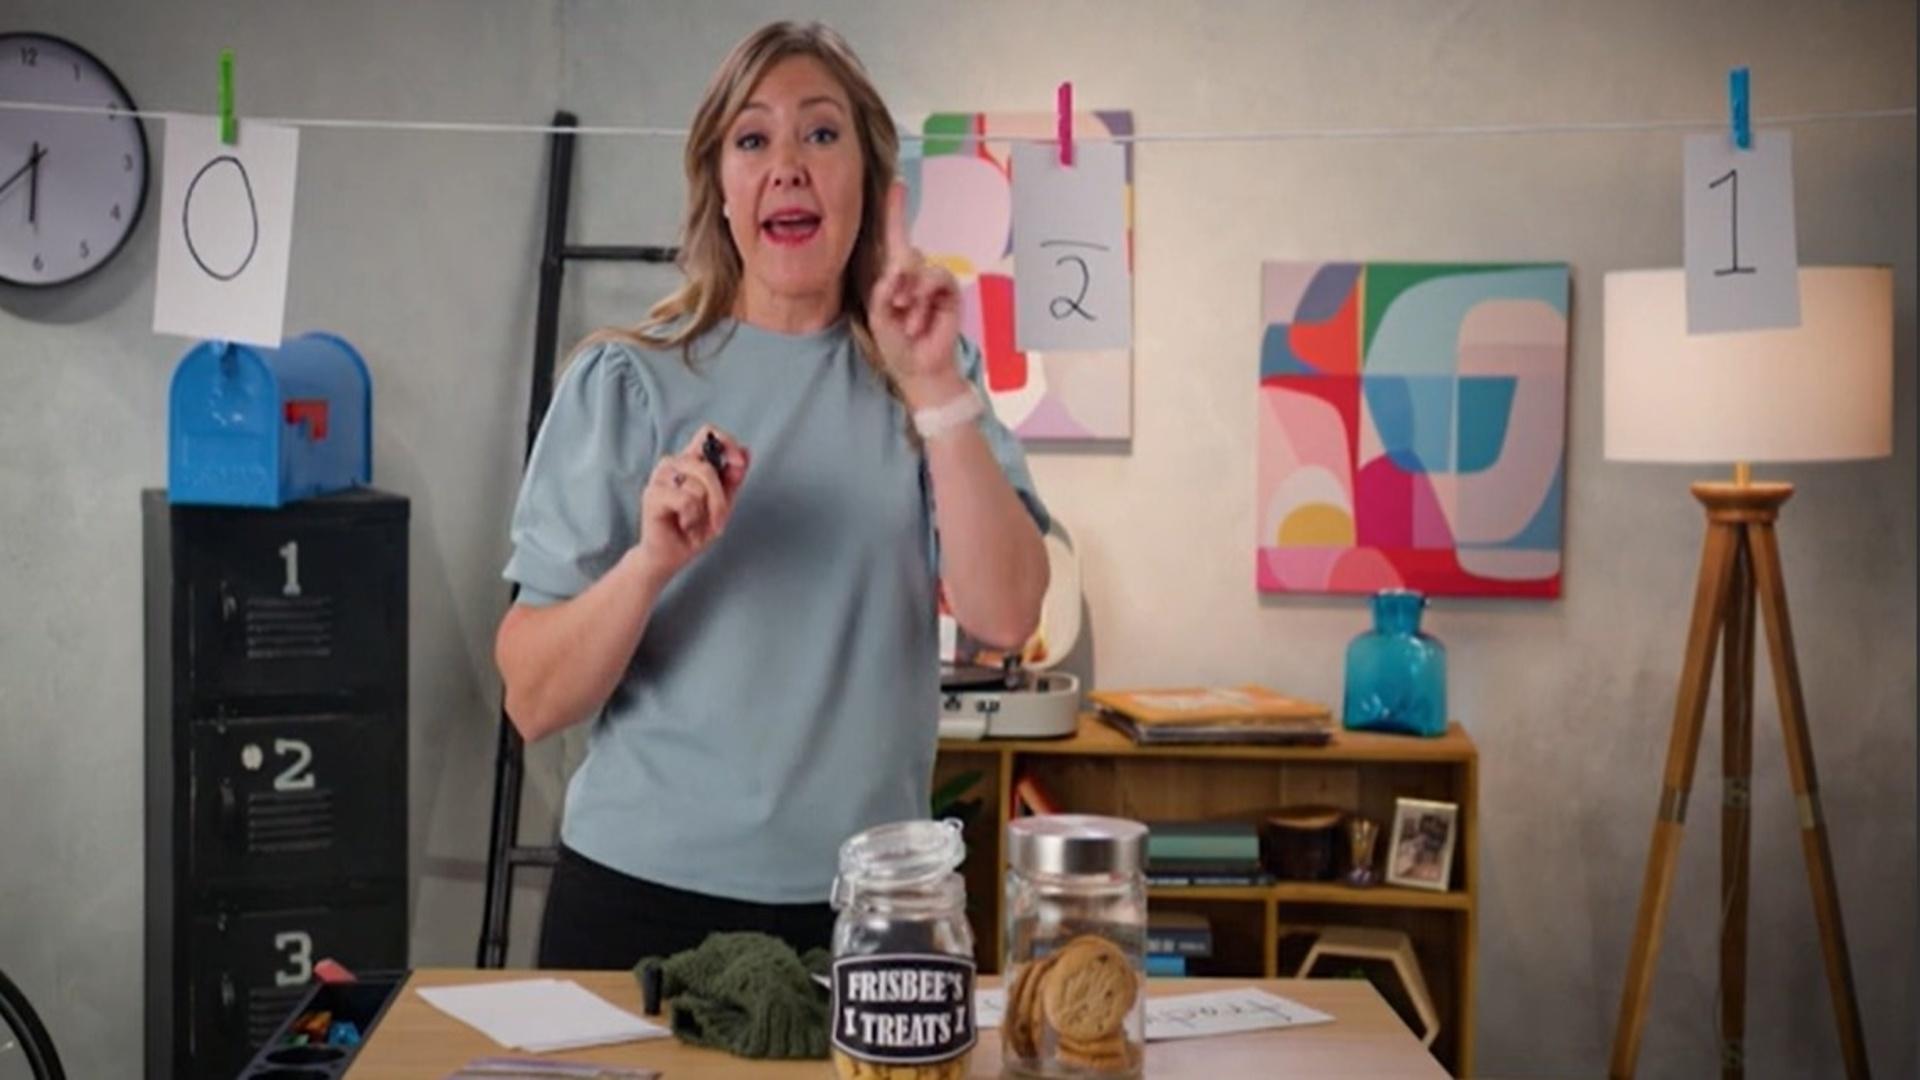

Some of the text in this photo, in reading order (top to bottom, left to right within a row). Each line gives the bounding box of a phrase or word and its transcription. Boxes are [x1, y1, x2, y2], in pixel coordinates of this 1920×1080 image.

[21, 47, 38, 66] 12
[73, 63, 80, 81] 1
[124, 153, 133, 171] 3
[110, 203, 121, 220] 4
[1708, 168, 1757, 276] 1
[32, 254, 43, 271] 6
[80, 240, 90, 259] 5
[1049, 255, 1097, 321] 2
[279, 541, 301, 596] 1
[273, 738, 316, 791] 2
[275, 930, 313, 987] 3
[848, 969, 964, 1003] FRISBEE'S
[860, 1012, 952, 1047] TREATS
